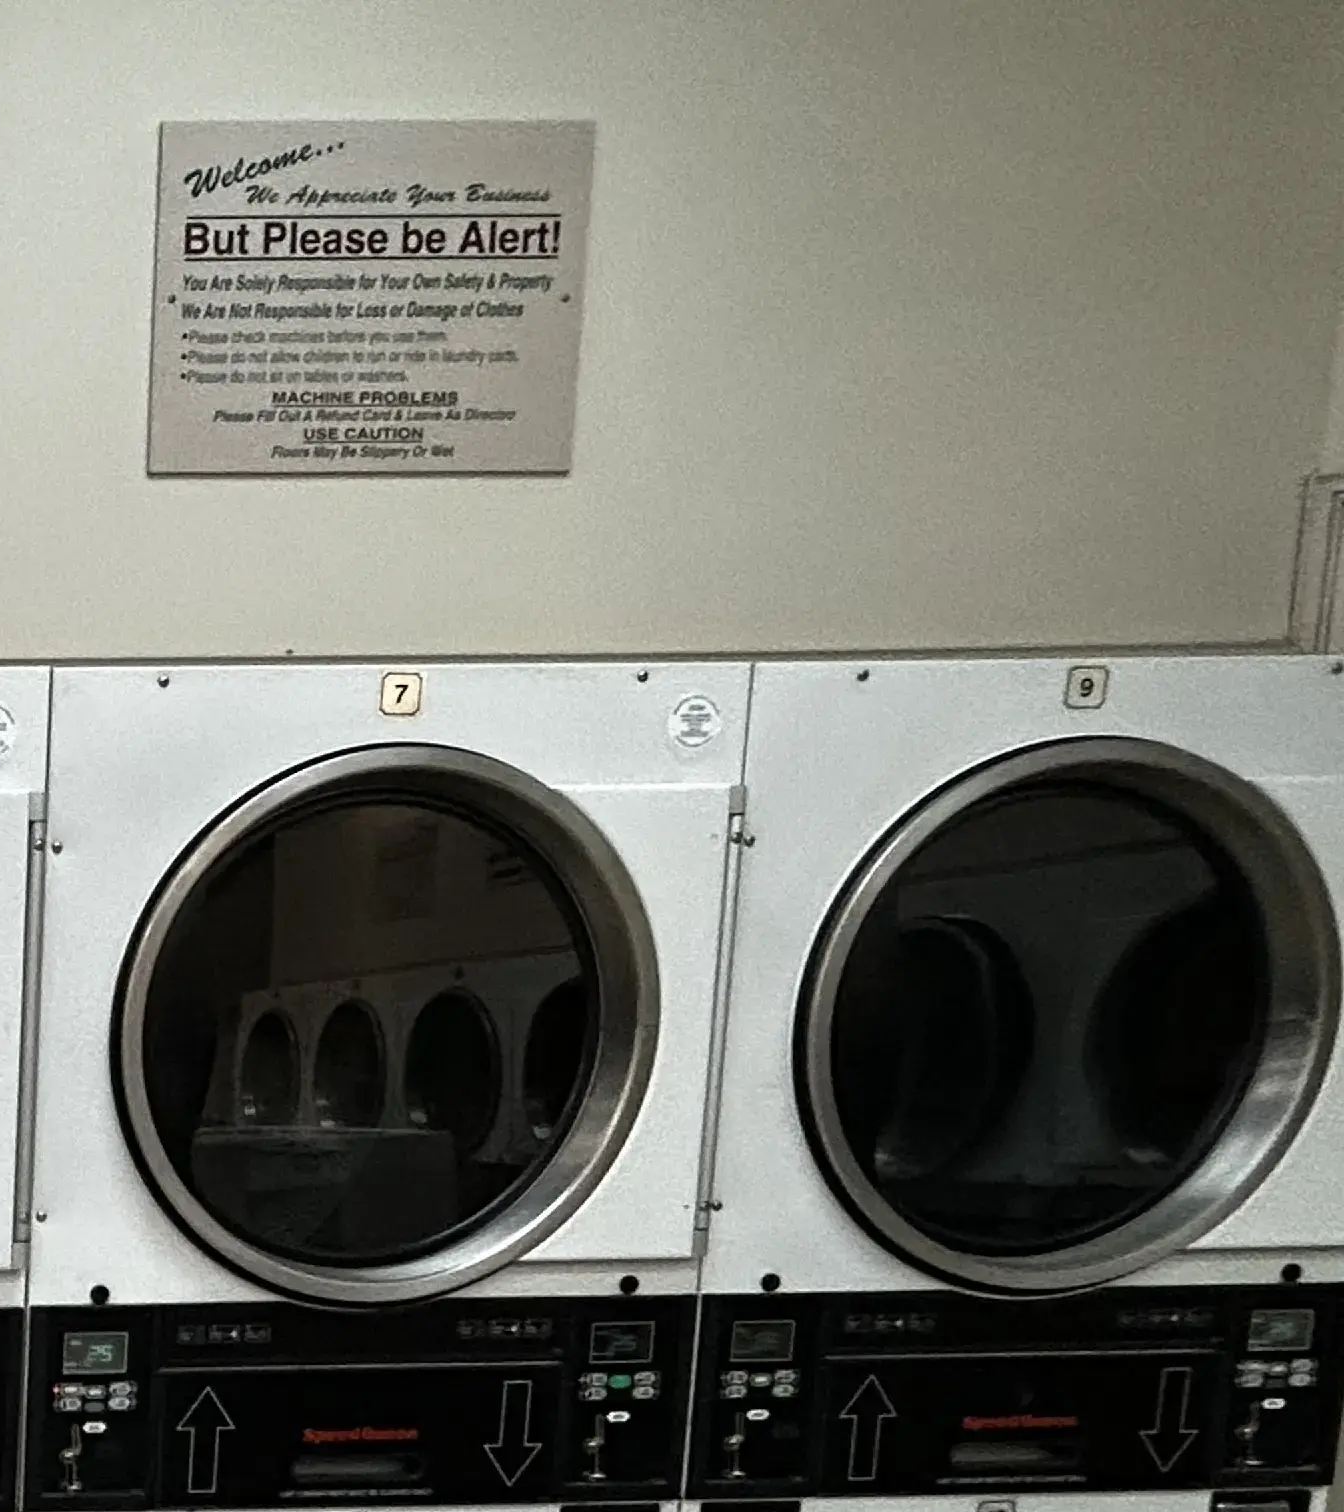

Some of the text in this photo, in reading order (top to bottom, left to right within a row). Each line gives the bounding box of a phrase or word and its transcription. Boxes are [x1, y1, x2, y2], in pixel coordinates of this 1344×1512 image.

[184, 141, 345, 198] Welcome...
[245, 183, 552, 208] We Appreciate Your Business
[184, 220, 562, 256] But Please be Alert!
[182, 274, 208, 291] You
[210, 275, 233, 291] Are
[358, 273, 377, 290] for
[380, 274, 410, 290] Your
[412, 273, 442, 290] Own
[444, 272, 484, 293] Safety
[486, 273, 496, 290] &
[498, 272, 554, 293] Property
[181, 301, 524, 321] We Are Not Responsible for Loss or Damage of Clothes
[272, 391, 458, 404] MACHINE PROBLEMS
[214, 410, 254, 422] Please
[303, 427, 424, 440] USE CAUTION
[394, 684, 409, 704] 7
[1079, 678, 1094, 697] 9
